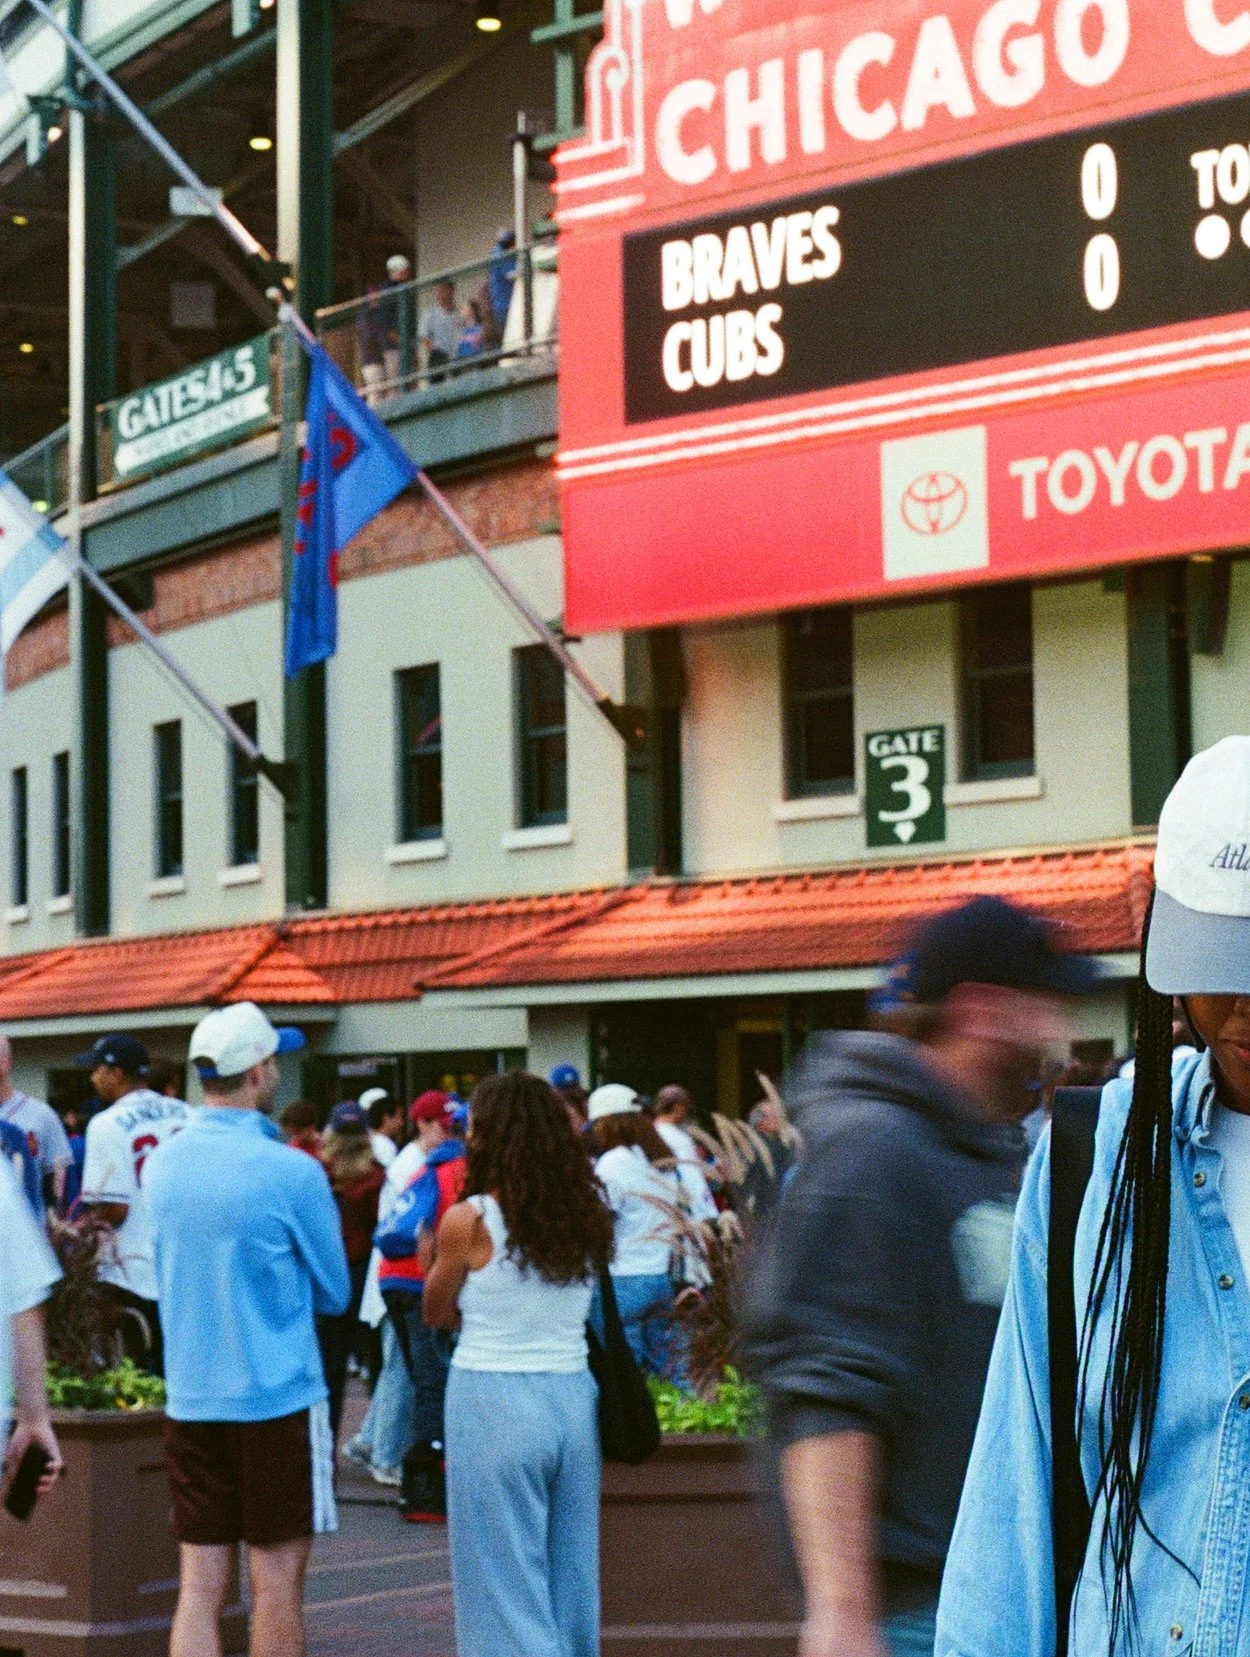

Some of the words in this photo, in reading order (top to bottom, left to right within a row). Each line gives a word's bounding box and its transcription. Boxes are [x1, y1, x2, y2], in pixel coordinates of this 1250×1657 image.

[655, 0, 1130, 185] CHICAGO
[659, 206, 842, 311] BRAVES
[1080, 143, 1118, 220] 0
[661, 303, 785, 392] CUBS
[1083, 233, 1120, 311] 0
[117, 367, 207, 439] GATES
[868, 729, 940, 758] GATE
[878, 754, 932, 823] 3
